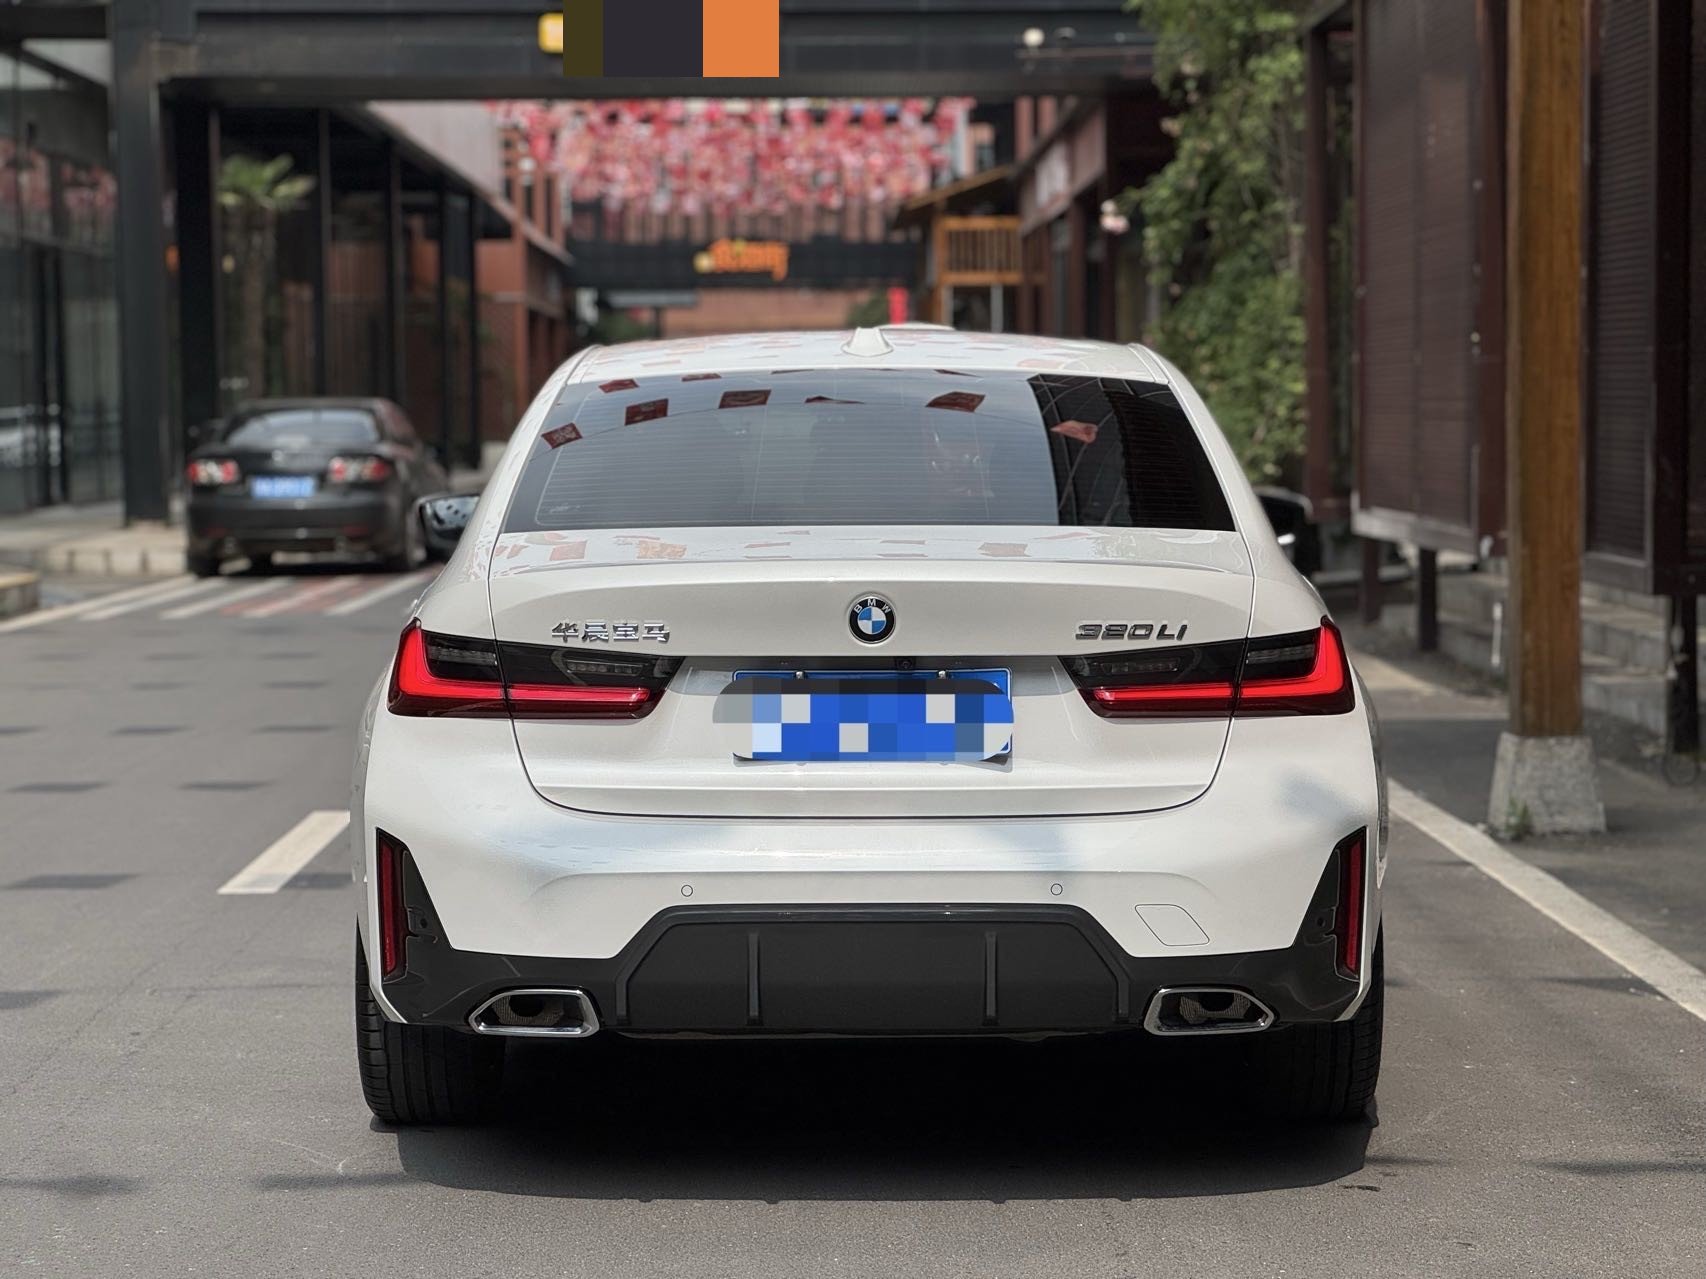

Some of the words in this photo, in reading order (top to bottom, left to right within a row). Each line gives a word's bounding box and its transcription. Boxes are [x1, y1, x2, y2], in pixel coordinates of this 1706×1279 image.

[853, 598, 891, 614] BMW
[551, 621, 670, 643] 华晨宝马
